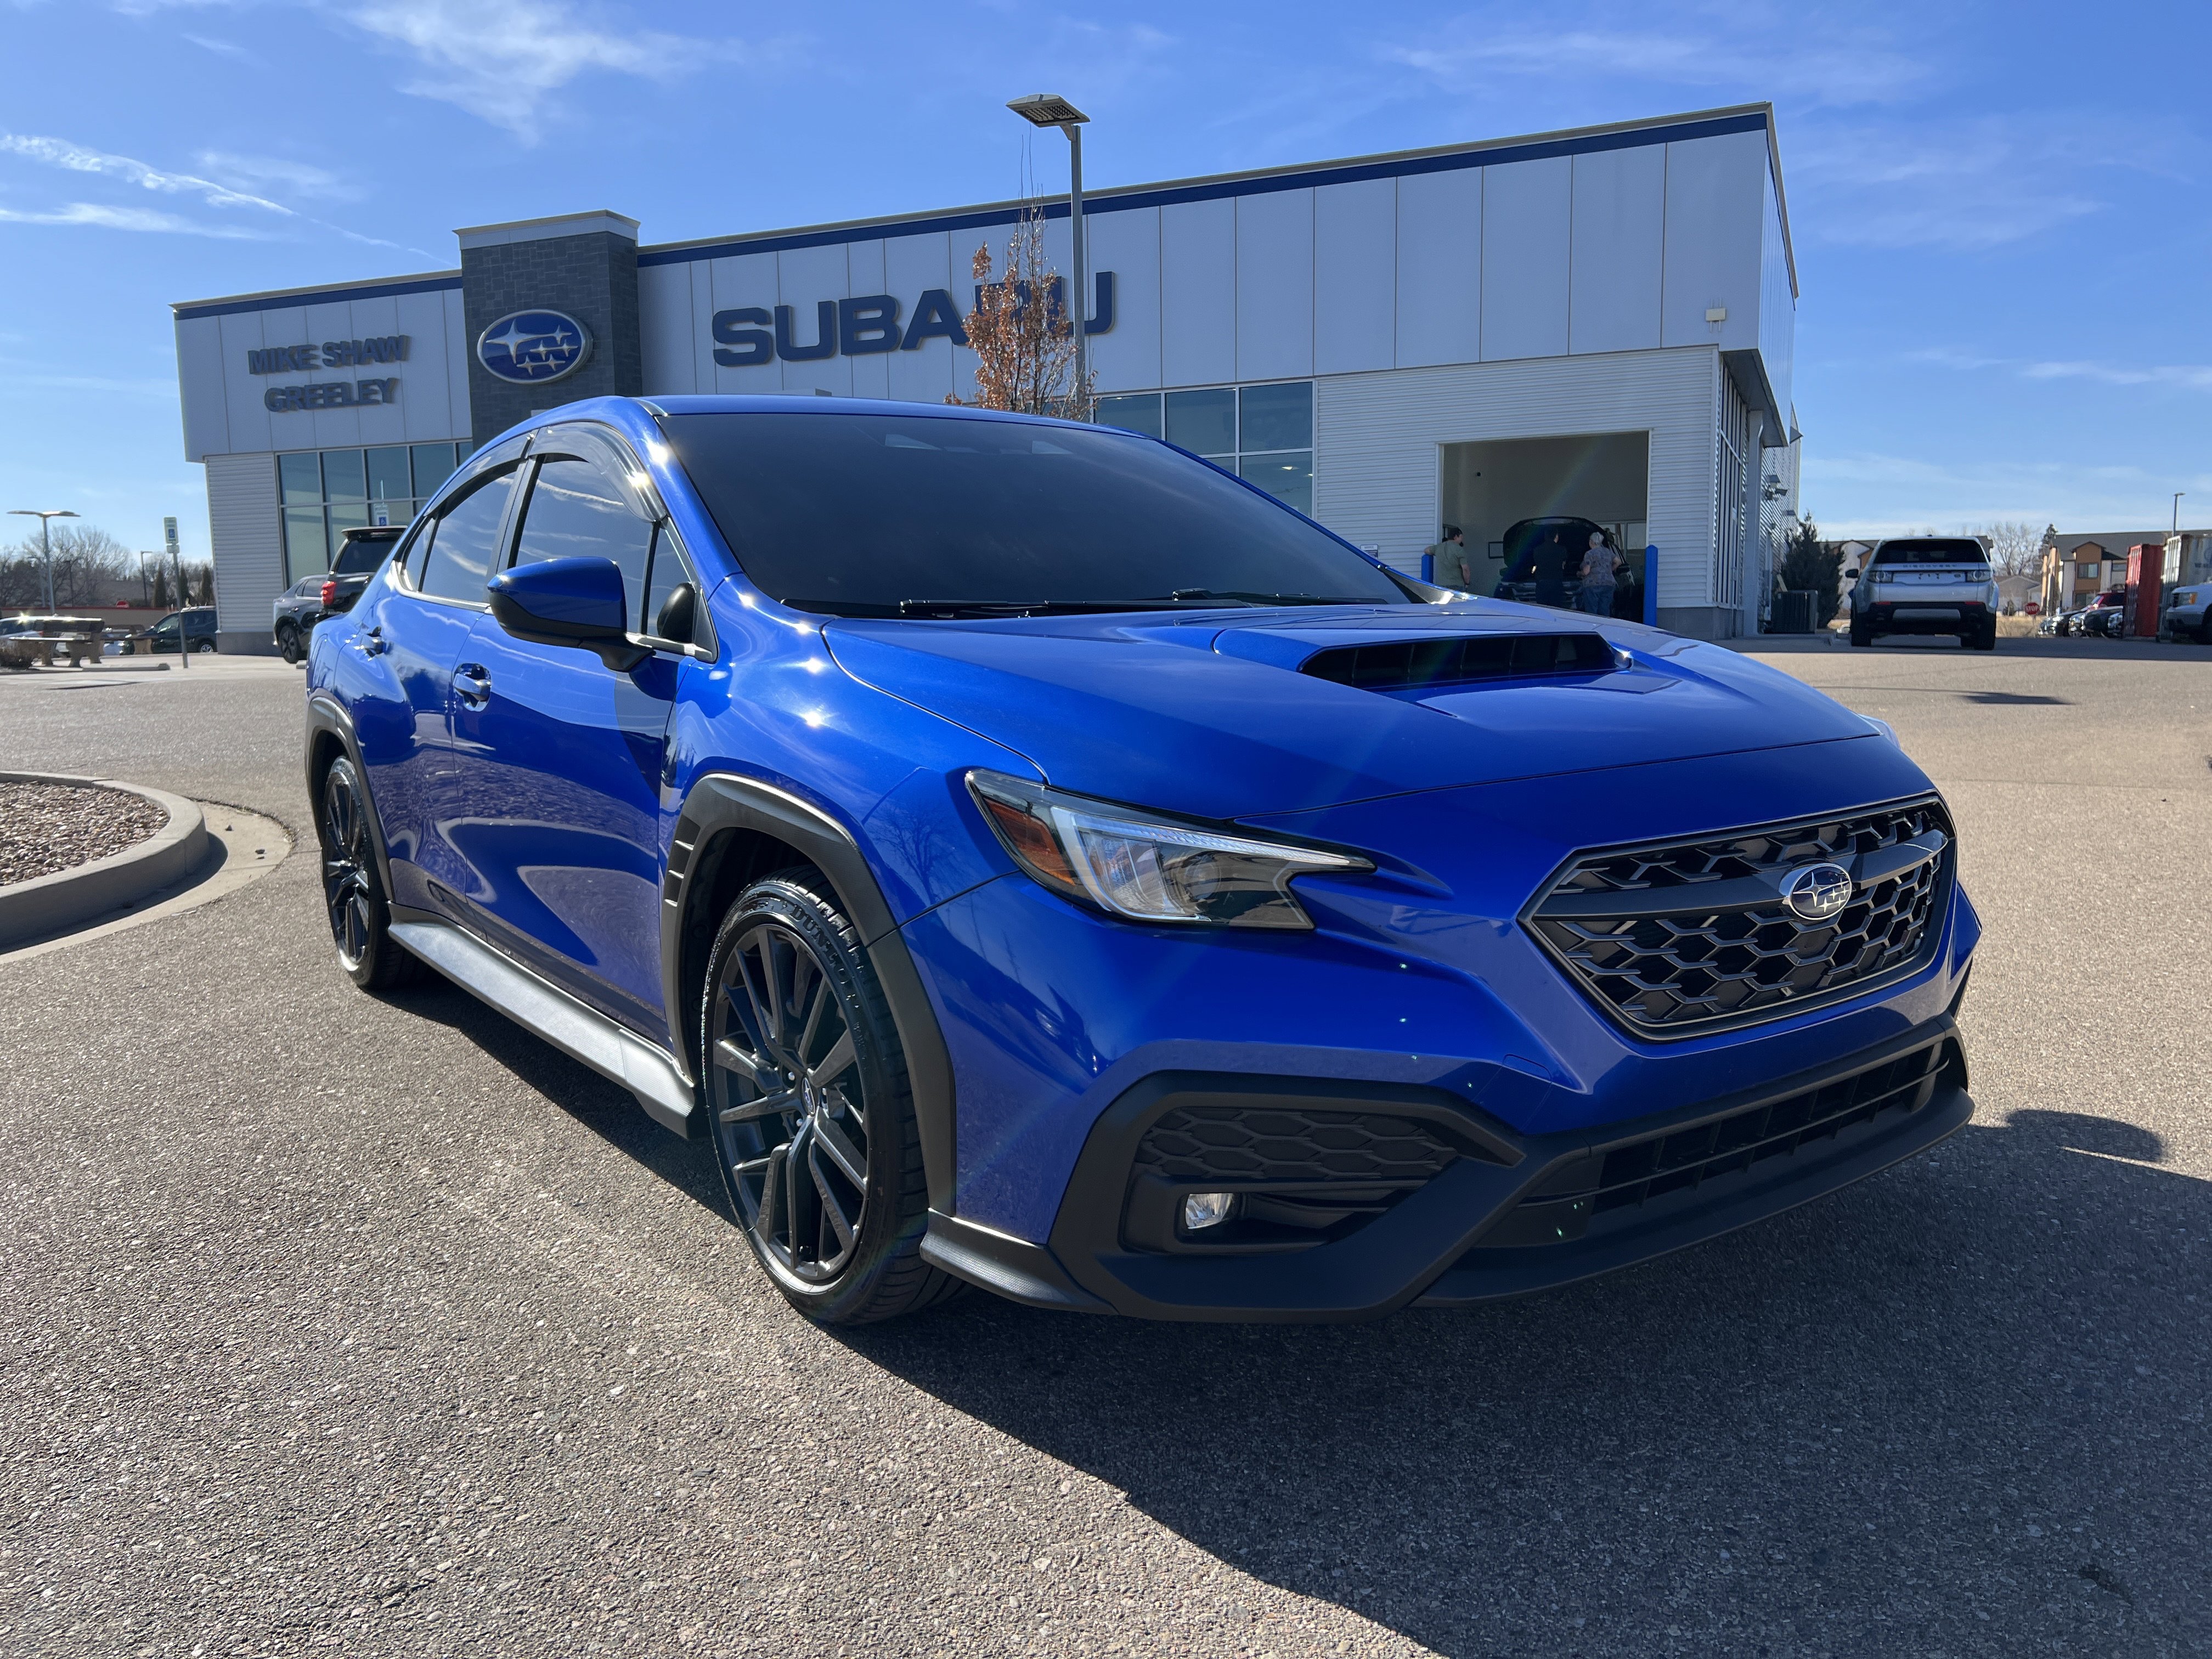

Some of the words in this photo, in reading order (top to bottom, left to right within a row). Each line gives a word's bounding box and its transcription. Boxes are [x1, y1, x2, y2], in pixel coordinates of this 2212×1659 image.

[247, 344, 322, 375] MIKE
[322, 335, 411, 368] SHAW
[264, 377, 399, 413] GREELEY
